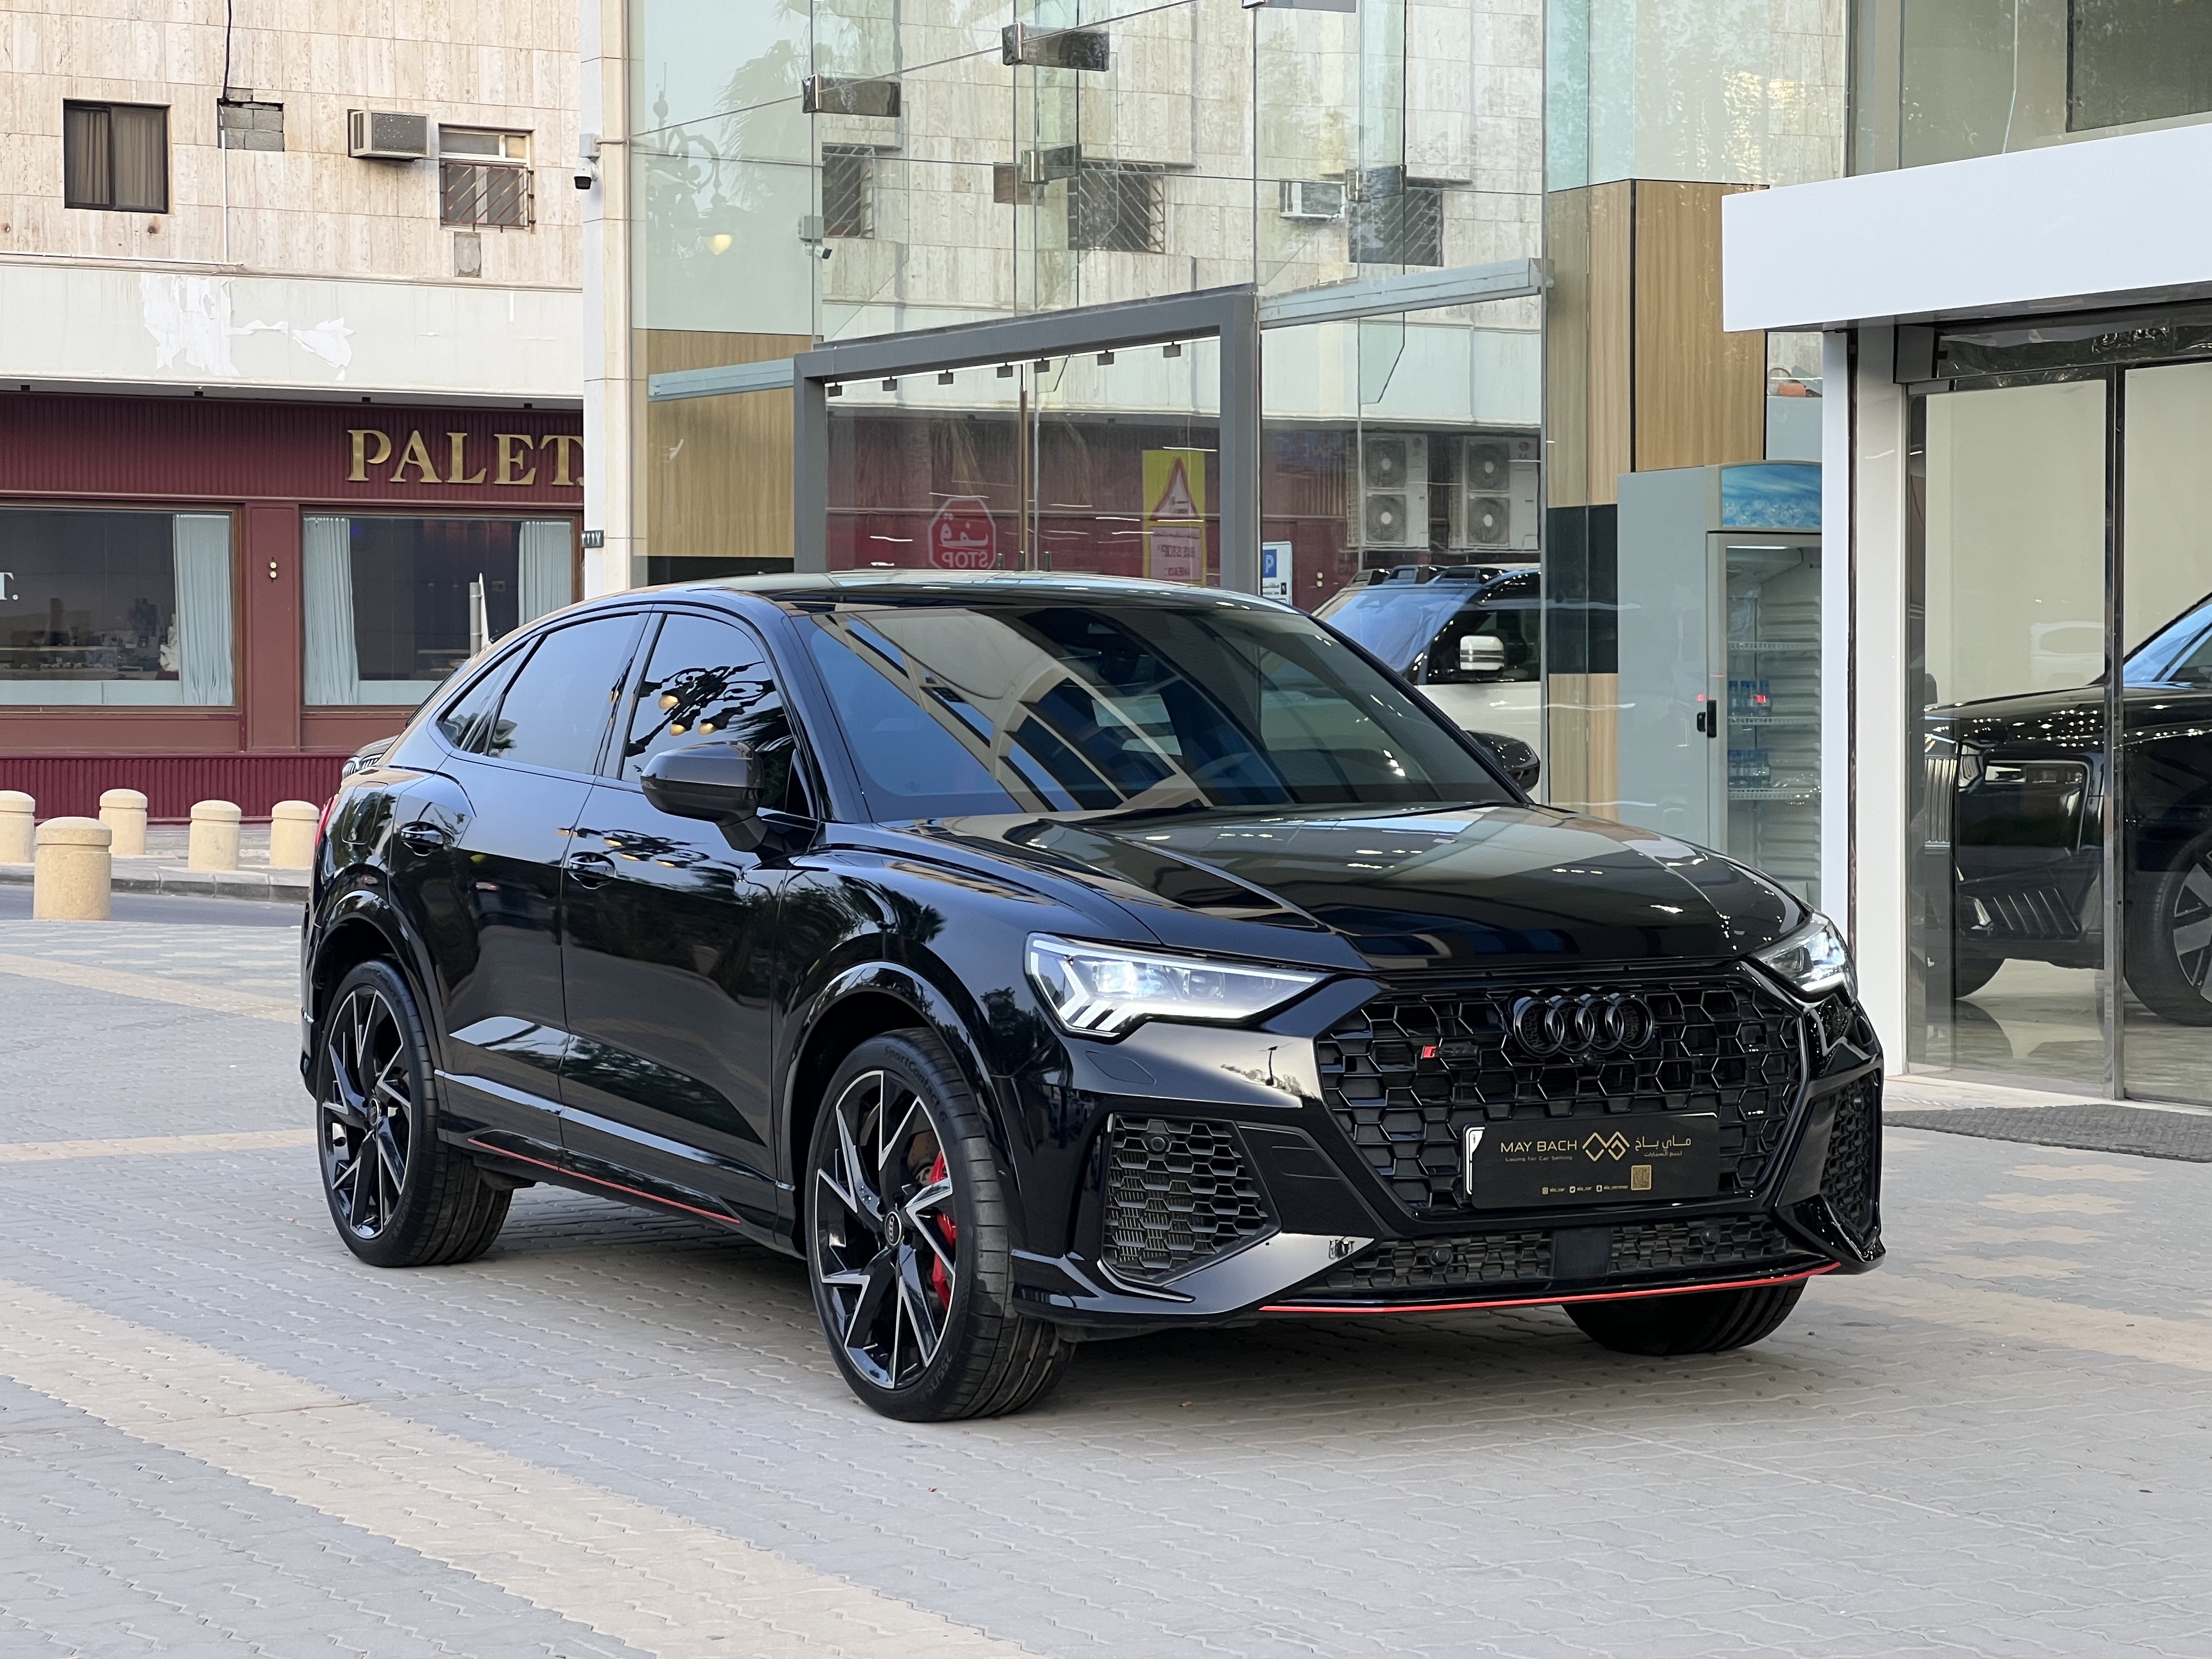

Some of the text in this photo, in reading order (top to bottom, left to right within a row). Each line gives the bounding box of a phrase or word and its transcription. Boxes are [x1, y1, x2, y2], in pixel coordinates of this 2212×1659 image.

[883, 1045, 947, 1122] SportContact 6
[1500, 1139, 1577, 1153] MAY BACH
[1635, 1135, 1691, 1152] ماي باخ
